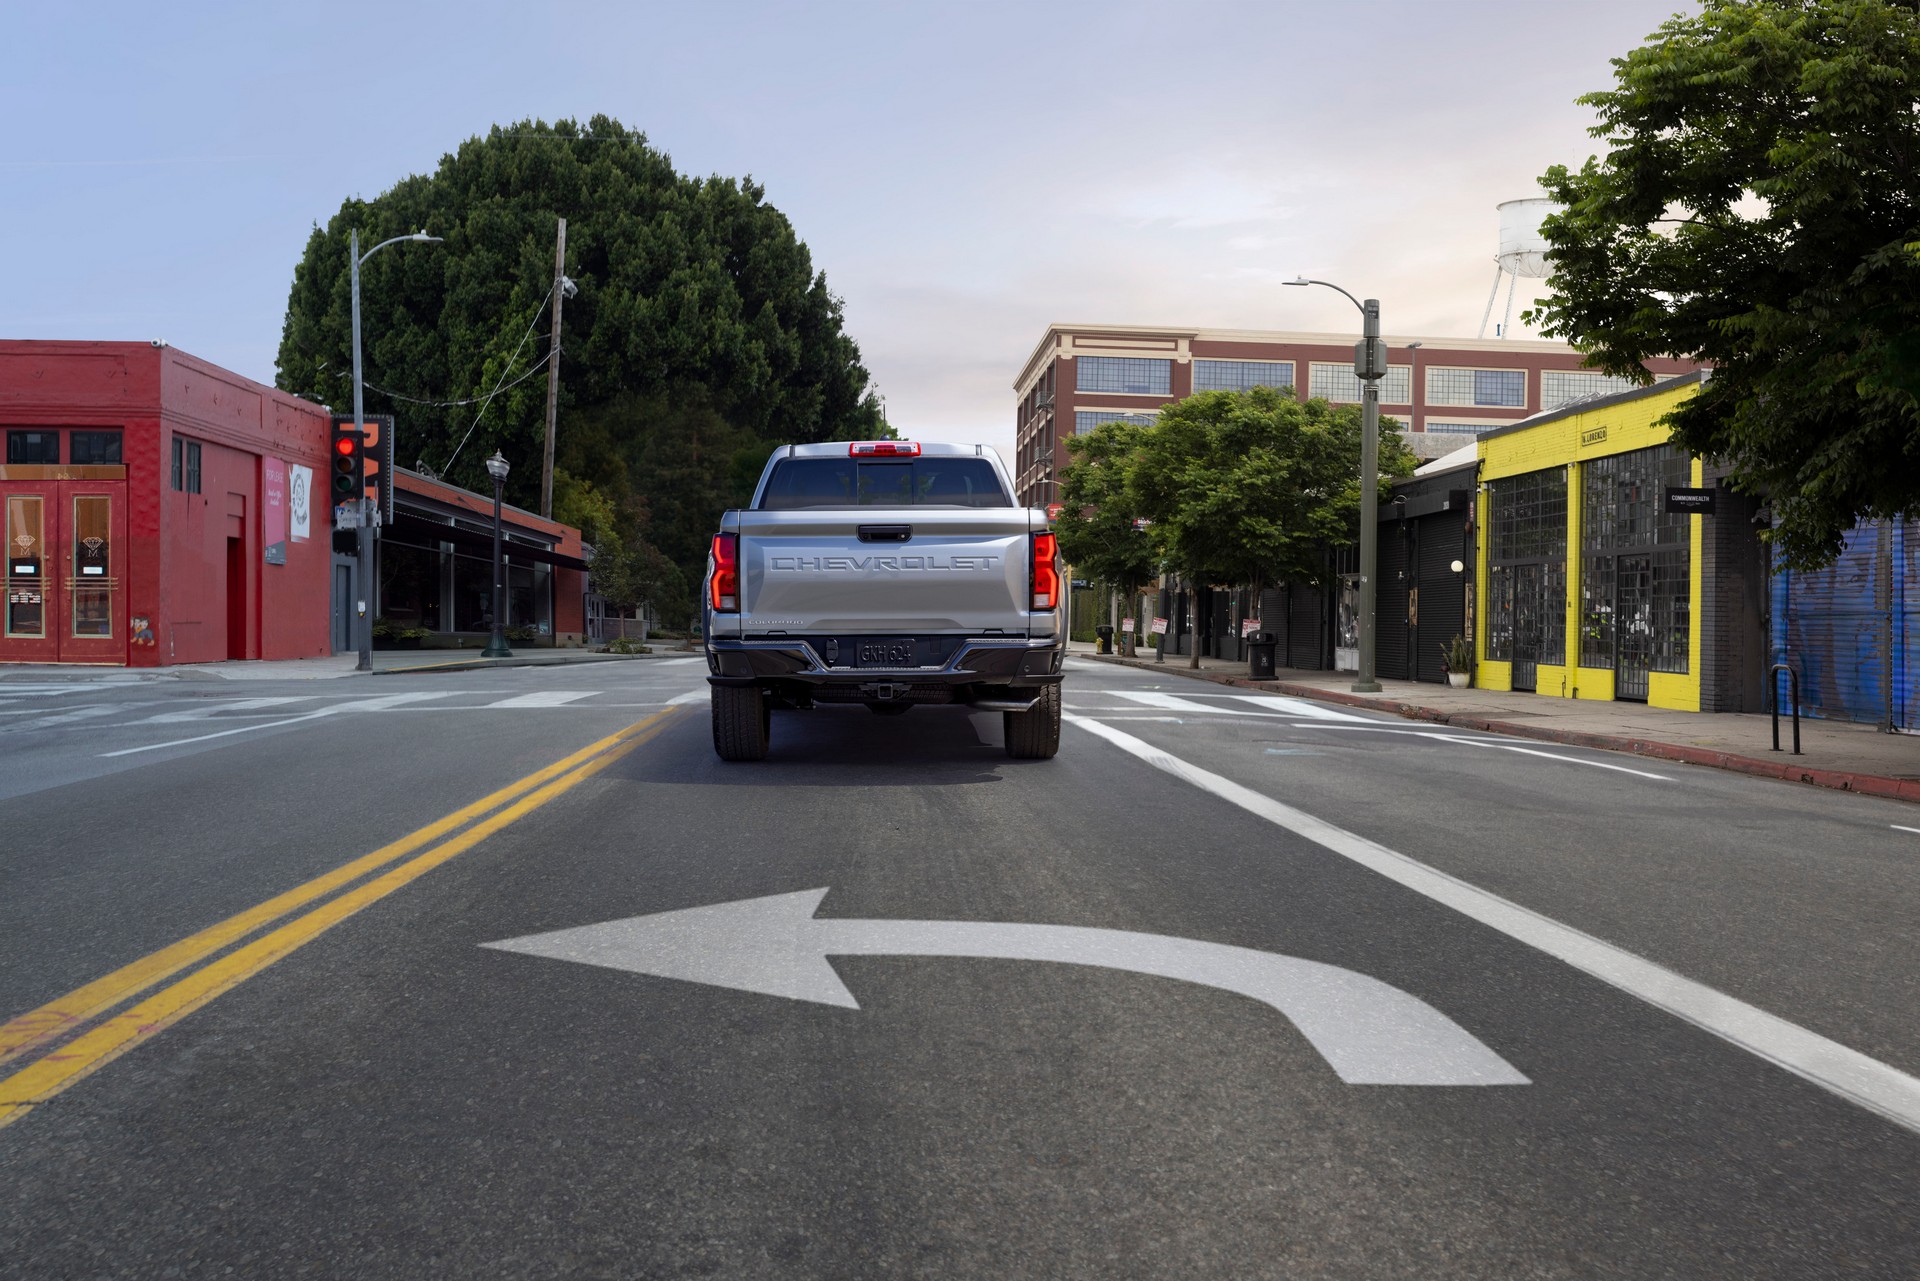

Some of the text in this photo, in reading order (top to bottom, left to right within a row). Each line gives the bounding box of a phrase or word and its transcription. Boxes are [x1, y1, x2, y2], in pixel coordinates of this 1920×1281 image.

[1671, 494, 1710, 502] COMMONWEALTH
[88, 549, 98, 557] M
[770, 556, 998, 571] CHEVROLET
[890, 645, 911, 661] 624
